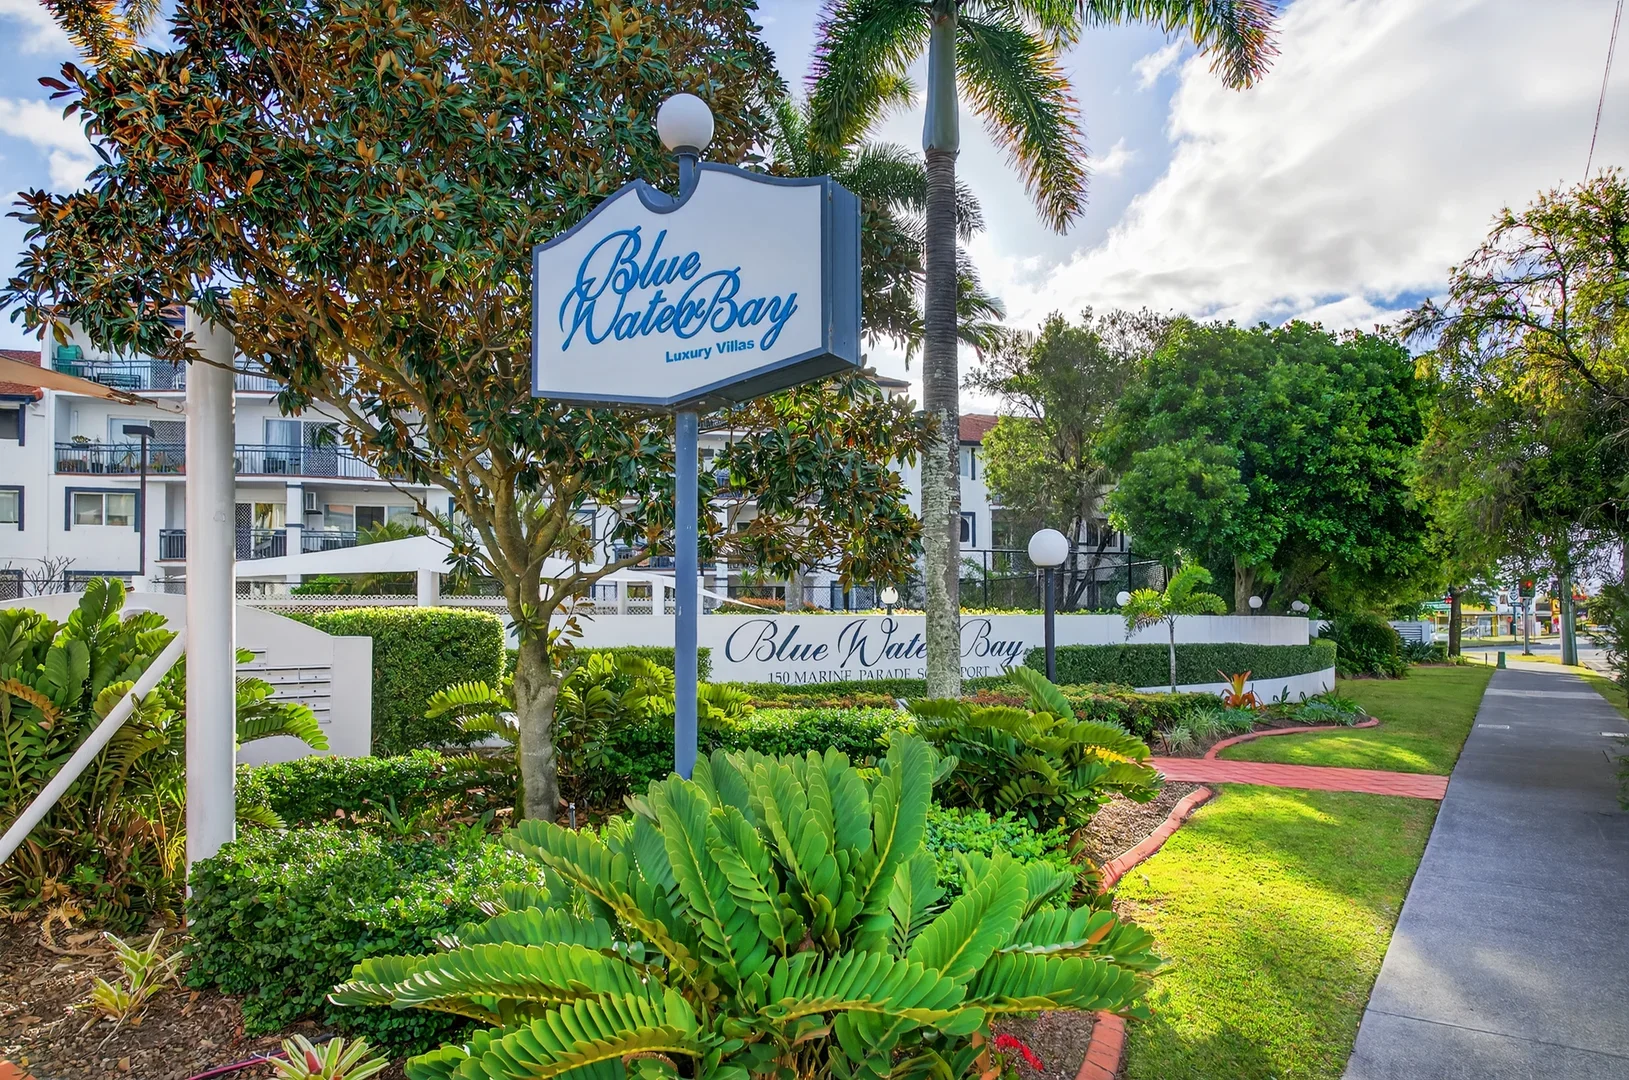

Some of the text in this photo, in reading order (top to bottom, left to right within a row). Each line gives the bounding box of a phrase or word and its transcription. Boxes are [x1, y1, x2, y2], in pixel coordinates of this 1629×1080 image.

[575, 225, 702, 300] Blue
[559, 266, 799, 352] Water Bay
[665, 339, 755, 363] Luxury Villas
[725, 617, 1024, 669] Blue Wate Bay
[768, 665, 990, 684] 150 MARINE PARADE SPORT
